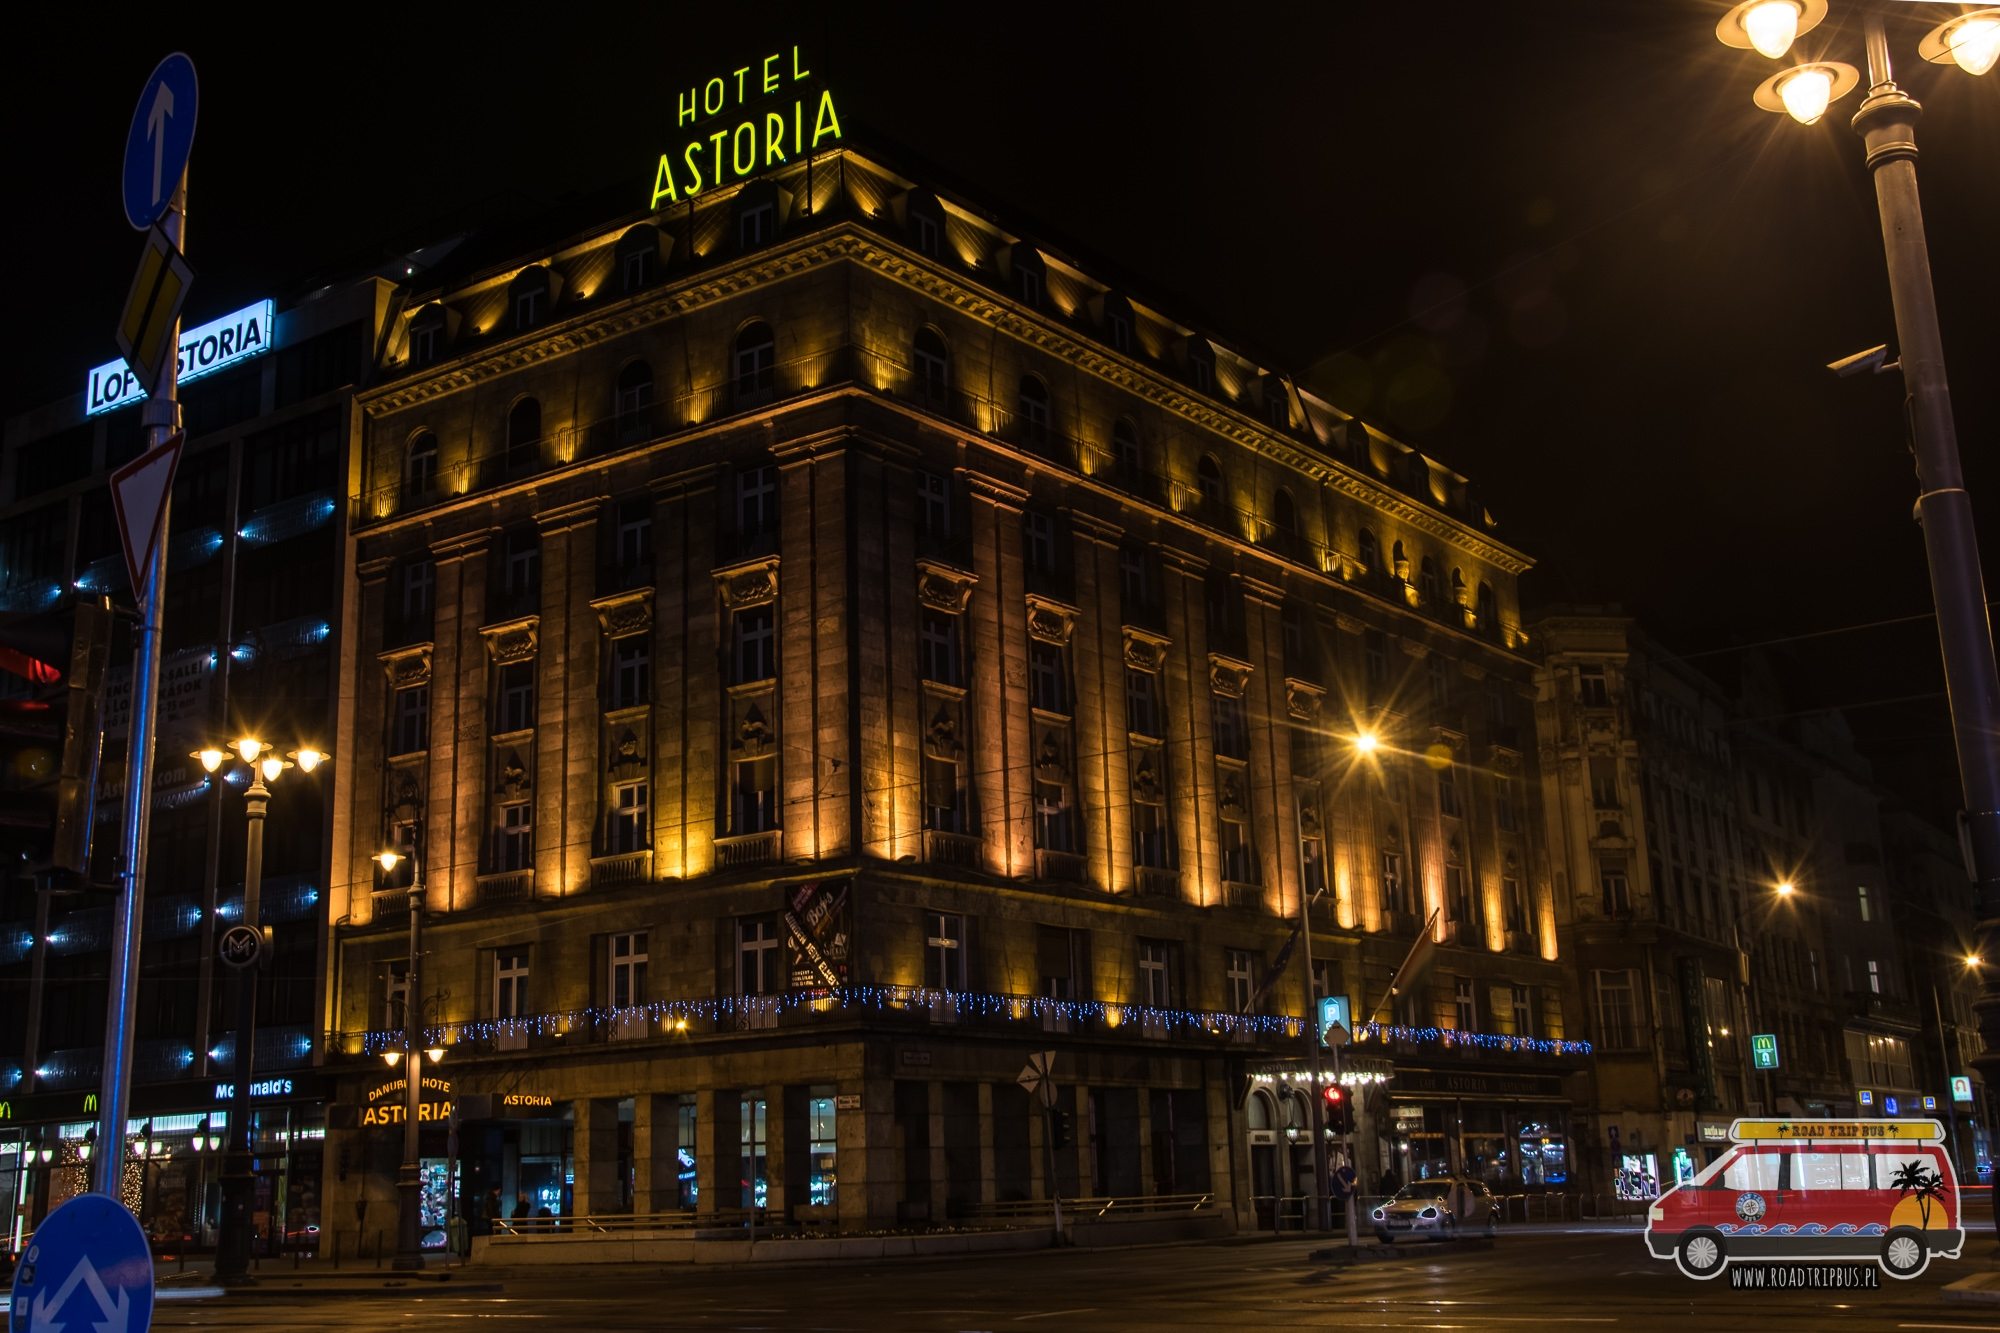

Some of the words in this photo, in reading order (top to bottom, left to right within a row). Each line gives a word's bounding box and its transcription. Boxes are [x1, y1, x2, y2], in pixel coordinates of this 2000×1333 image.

[678, 45, 810, 128] HOTEL
[650, 89, 842, 210] ASTORIA
[91, 366, 144, 410] LOF
[176, 317, 262, 377] STORIA
[215, 1079, 292, 1099] Mcnald's
[1446, 1077, 1487, 1091] ASTORIA
[503, 1094, 552, 1107] ASTORIA
[363, 1101, 451, 1126] ASTRIA
